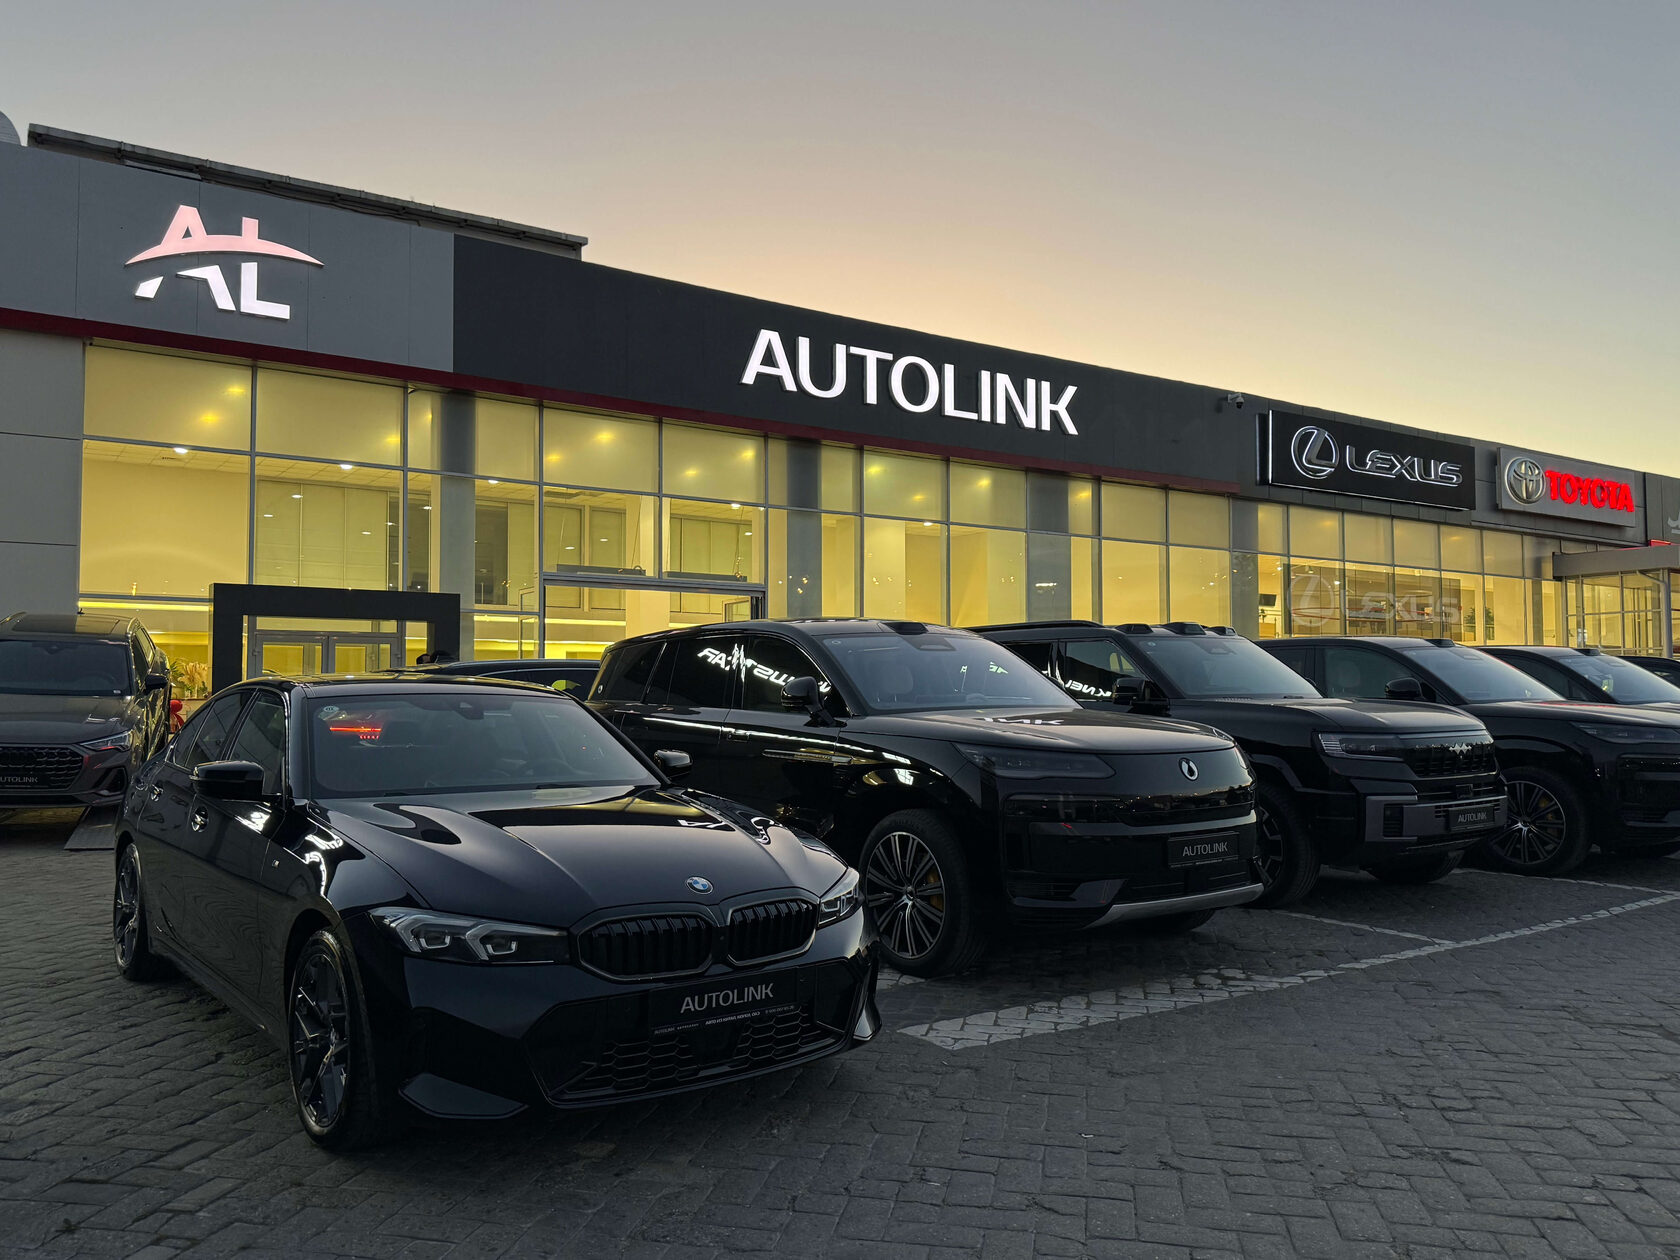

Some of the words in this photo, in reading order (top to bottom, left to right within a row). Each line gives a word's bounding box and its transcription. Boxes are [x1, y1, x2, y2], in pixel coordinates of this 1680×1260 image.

[125, 205, 325, 320] AL
[740, 329, 1079, 435] AUTOLINK
[1346, 445, 1463, 487] LEXUS
[1546, 470, 1635, 512] TOYOTA
[1458, 812, 1487, 823] AUTOLINK
[1183, 842, 1228, 857] AUTOLINK
[680, 983, 774, 1014] AUTOLINK
